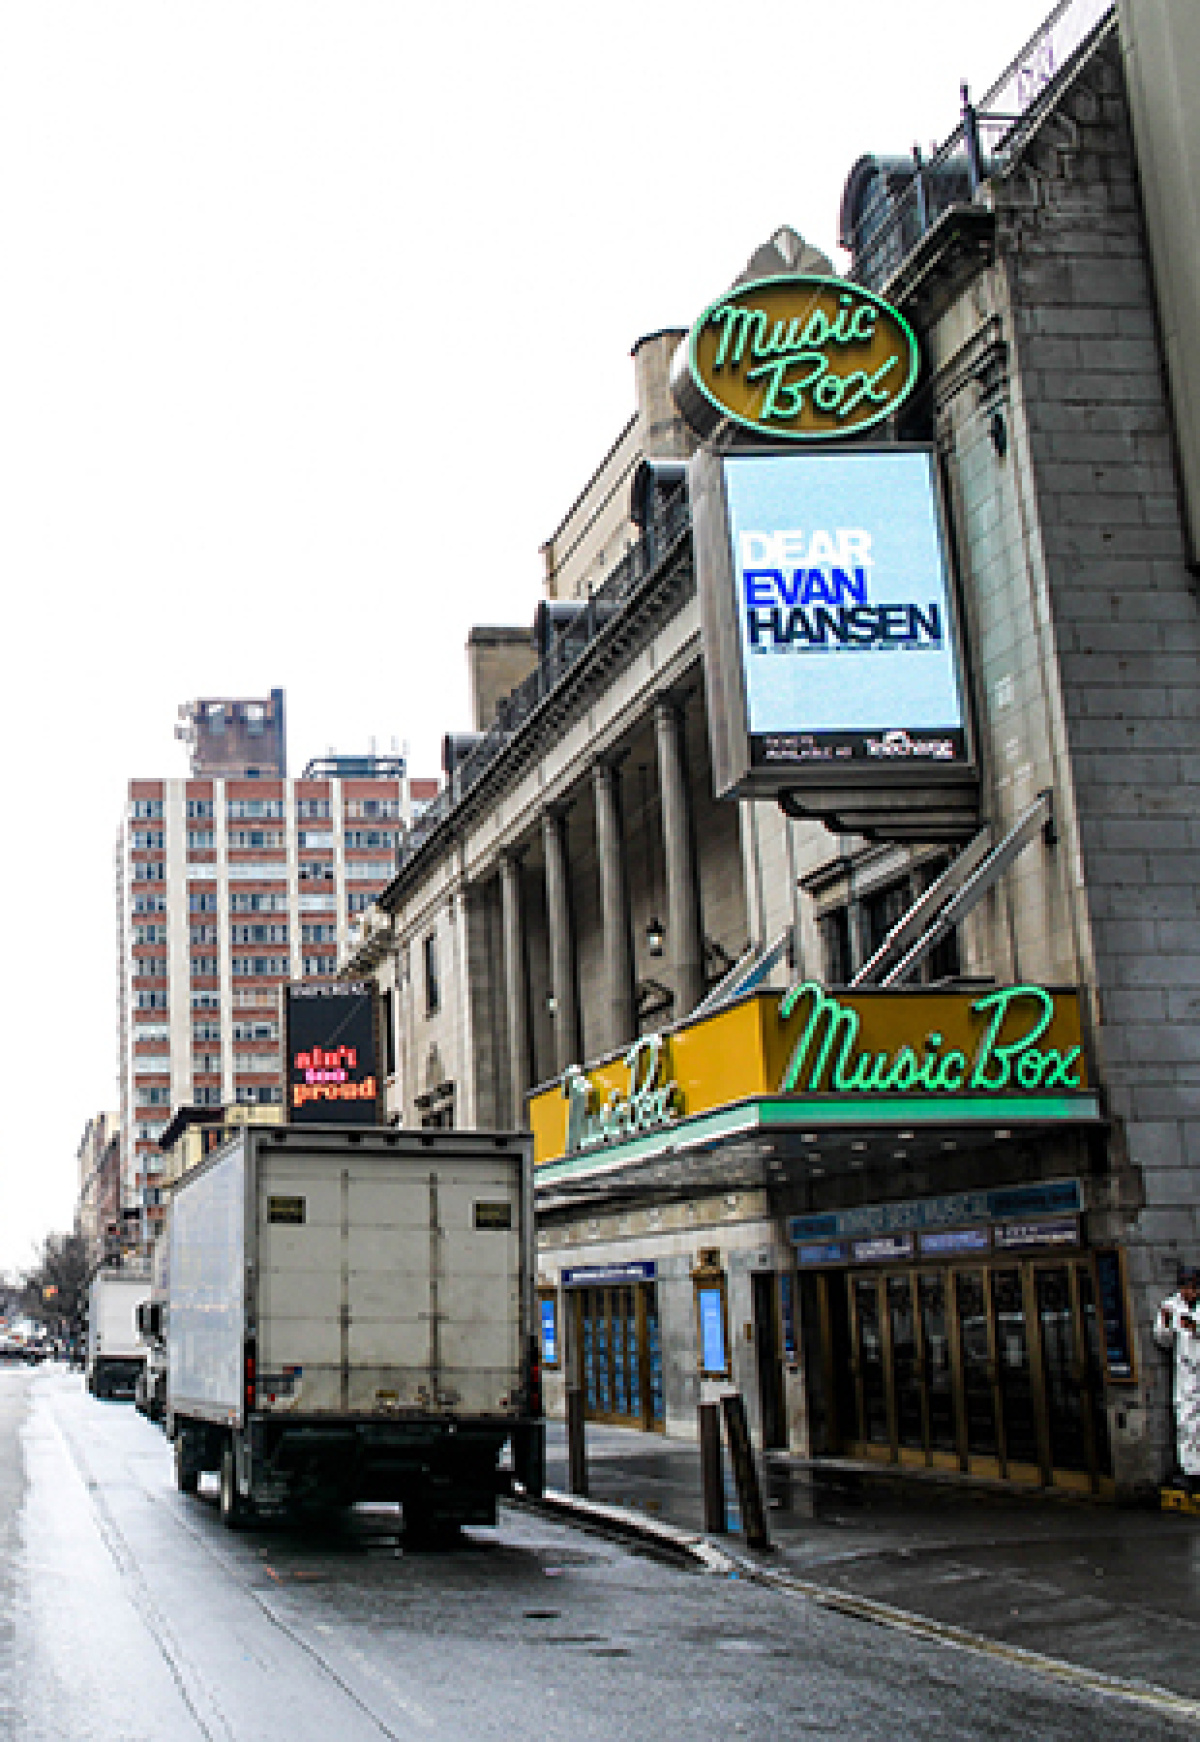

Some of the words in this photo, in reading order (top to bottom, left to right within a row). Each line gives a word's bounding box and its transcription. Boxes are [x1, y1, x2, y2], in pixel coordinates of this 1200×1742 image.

[710, 293, 877, 366] Music
[745, 351, 899, 420] Box
[738, 529, 873, 566] DEAR
[743, 568, 867, 605] EVAN
[746, 603, 941, 643] HANSEN
[777, 979, 966, 1091] Music
[967, 980, 1082, 1089] Box
[293, 1075, 377, 1108] proud
